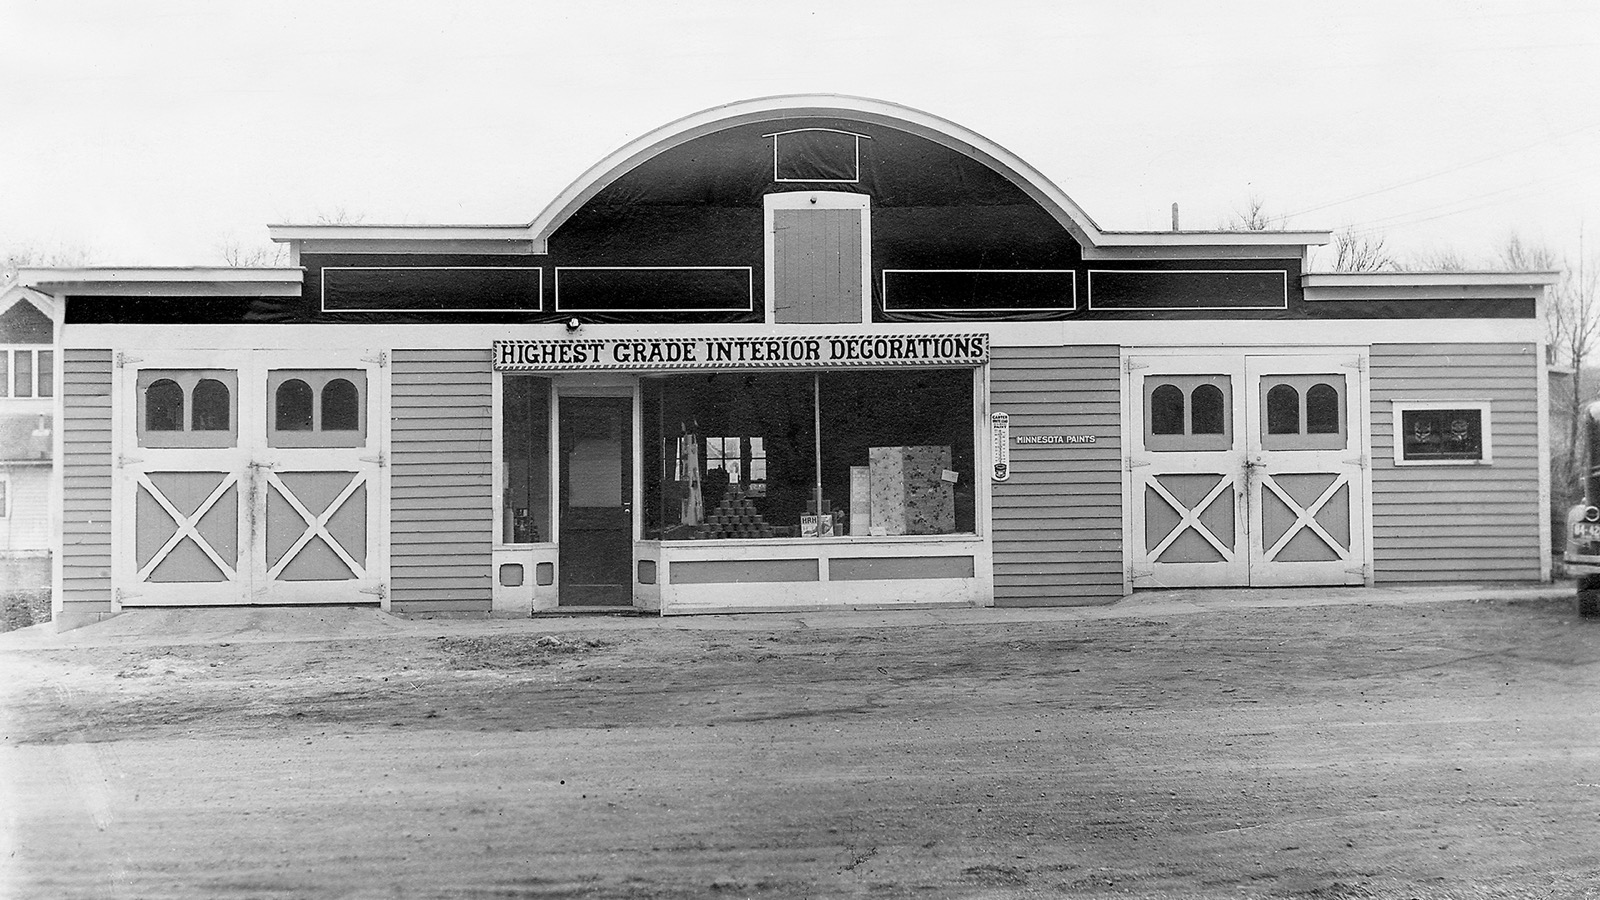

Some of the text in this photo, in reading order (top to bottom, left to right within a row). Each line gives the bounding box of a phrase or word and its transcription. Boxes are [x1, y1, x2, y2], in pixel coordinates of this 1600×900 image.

[500, 338, 983, 364] HIGHEST GRADE INTERIOR DECORATIONS
[1016, 435, 1096, 444] MINNESOTA PAINTS
